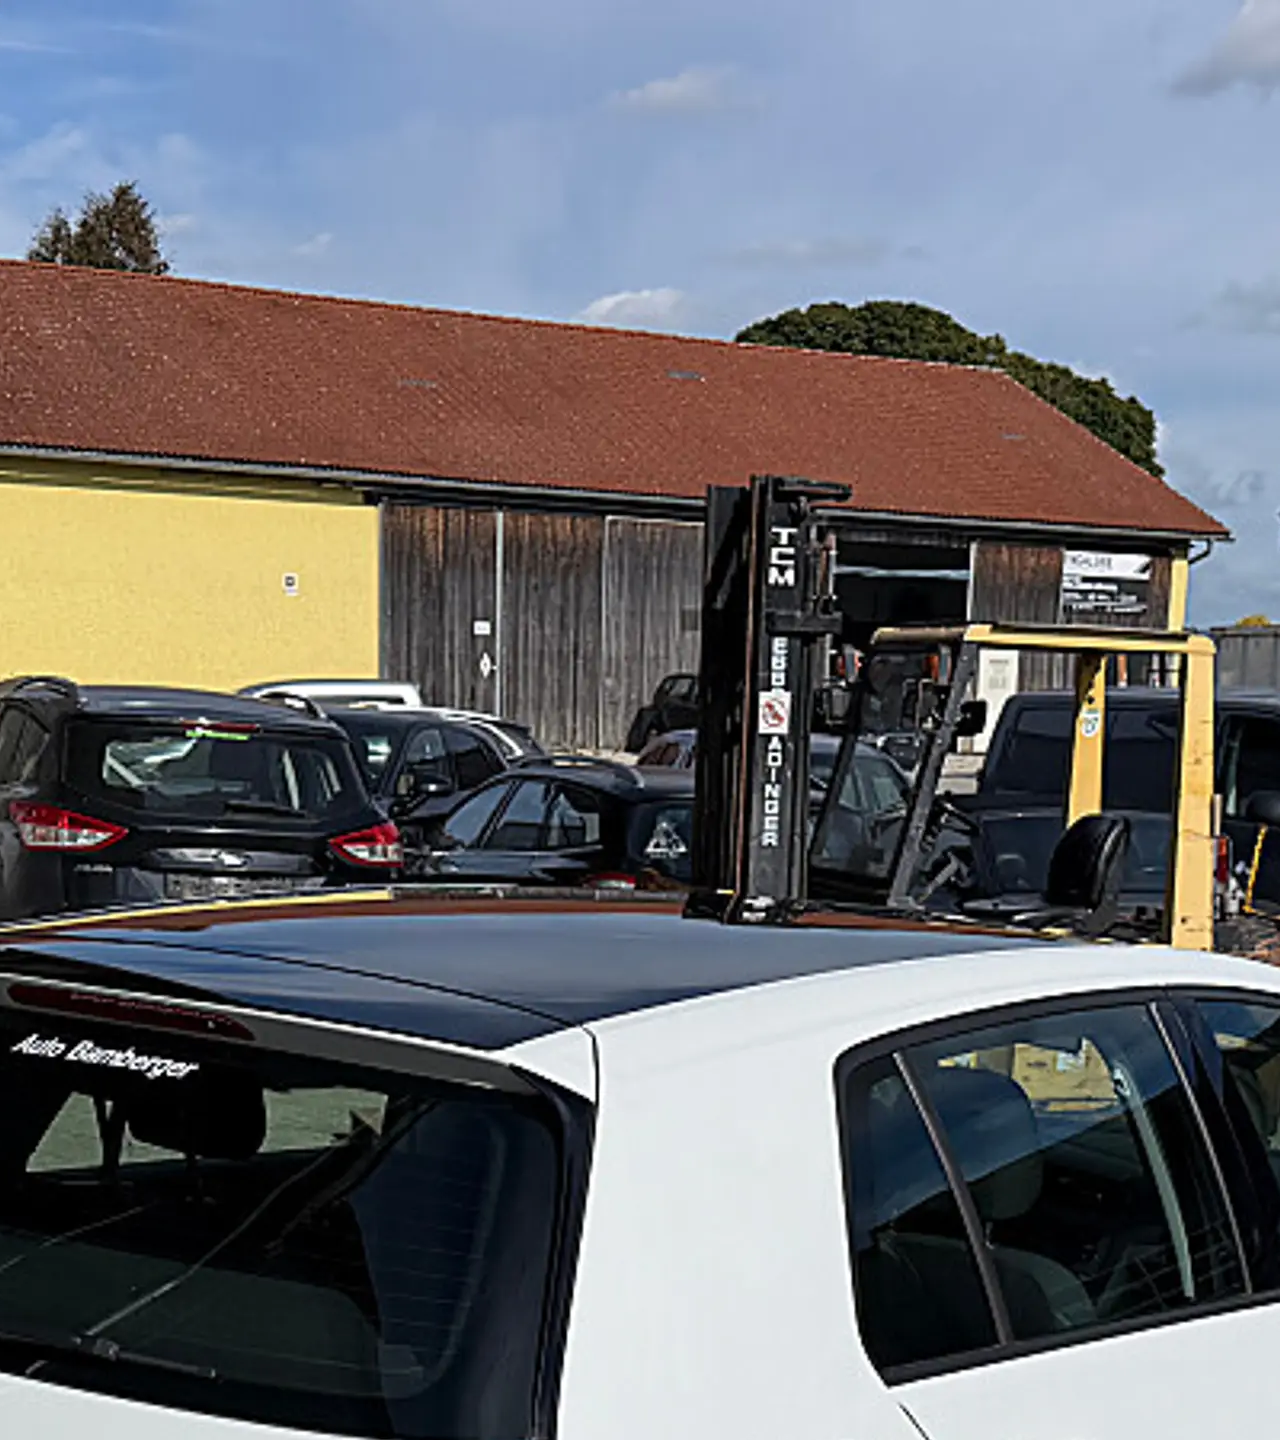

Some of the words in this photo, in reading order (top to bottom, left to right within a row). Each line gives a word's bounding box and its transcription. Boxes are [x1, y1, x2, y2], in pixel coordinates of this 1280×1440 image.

[767, 526, 799, 587] TCM
[10, 1033, 67, 1058] Auto
[65, 1039, 200, 1079] Bamberger
